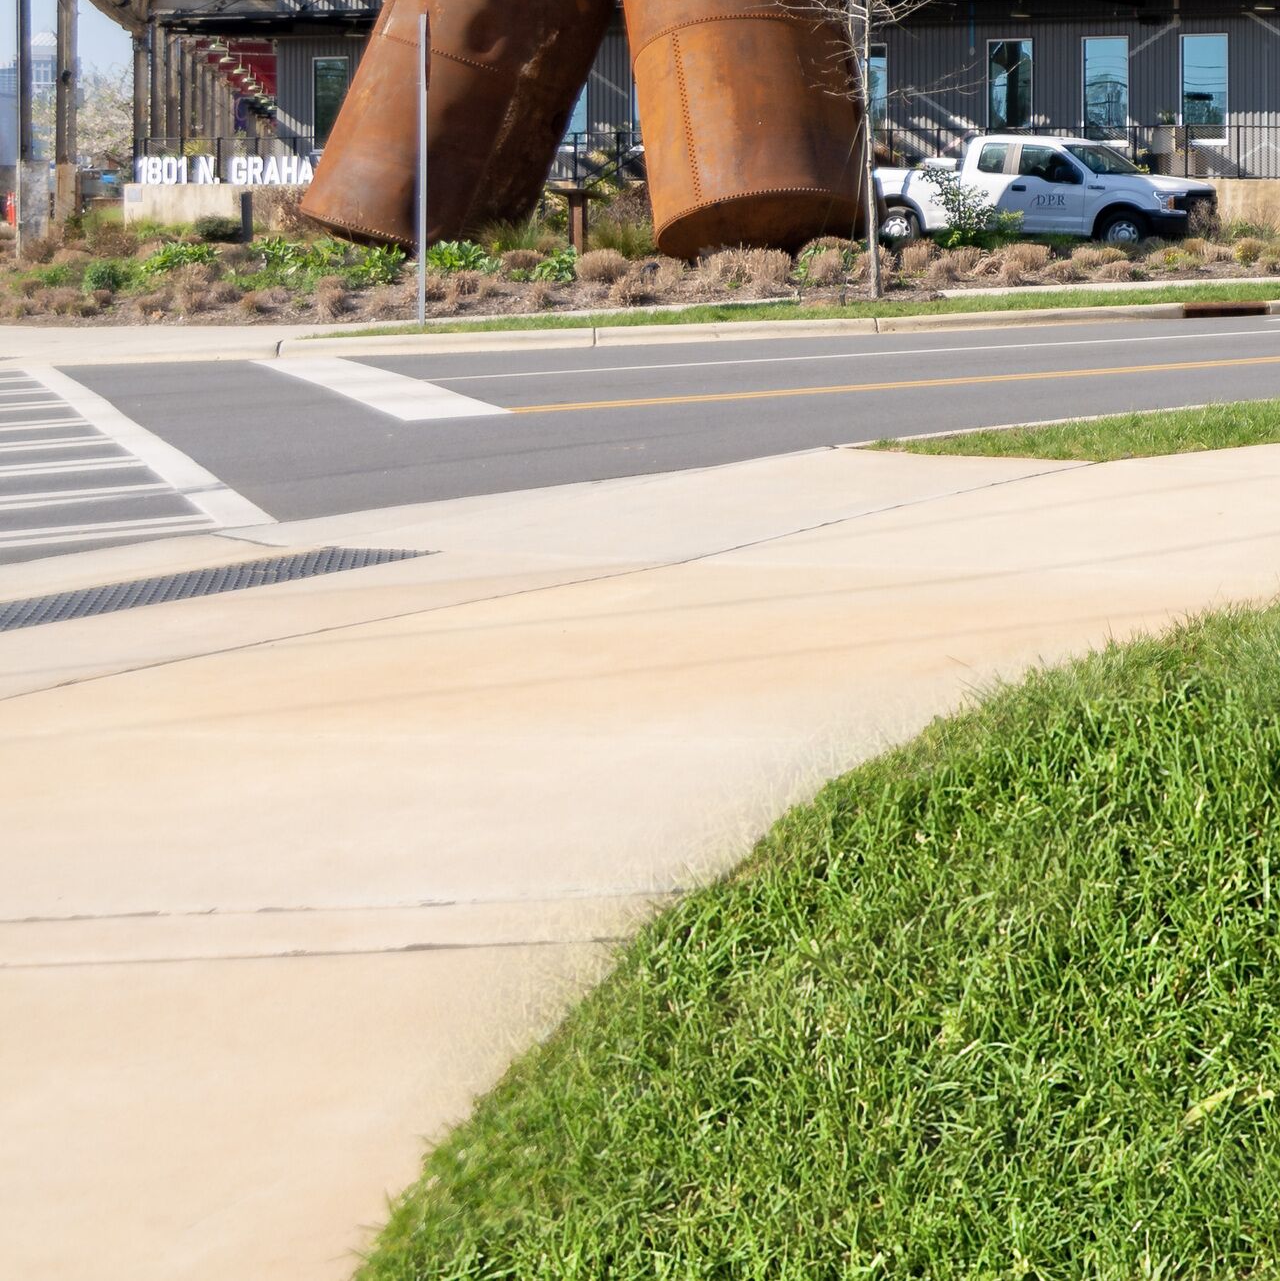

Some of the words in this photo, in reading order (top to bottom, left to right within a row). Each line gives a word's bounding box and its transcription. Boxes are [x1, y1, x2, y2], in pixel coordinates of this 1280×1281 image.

[137, 156, 188, 185] 1801
[197, 156, 220, 185] N.
[230, 156, 321, 185] GRAHA
[1035, 194, 1067, 206] DPR
